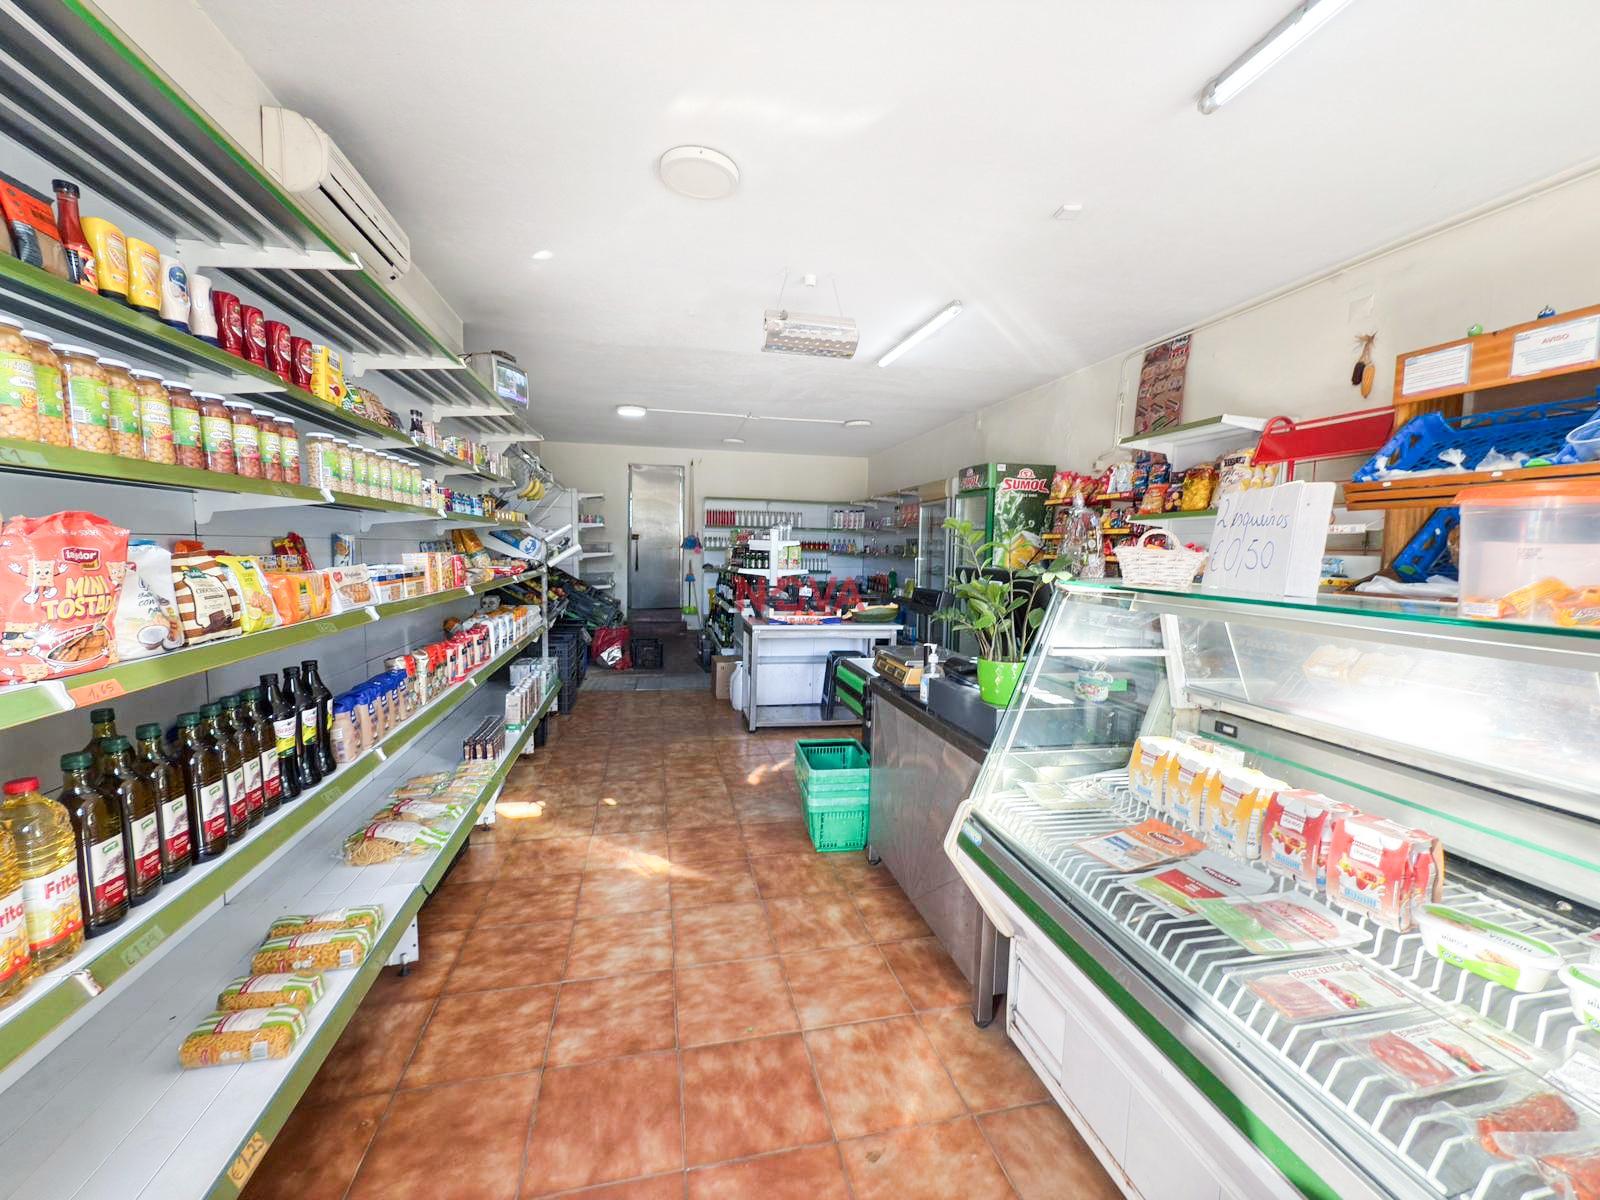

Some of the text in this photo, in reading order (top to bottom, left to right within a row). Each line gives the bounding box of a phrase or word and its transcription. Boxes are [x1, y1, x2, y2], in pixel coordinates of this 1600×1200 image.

[1541, 332, 1569, 345] AVISO
[1001, 478, 1050, 494] SUMOL
[1217, 498, 1230, 528] 2
[1210, 536, 1276, 578] €0,50
[65, 575, 110, 598] MINI
[41, 595, 116, 620] TOSTAD
[88, 682, 114, 700] 1,65
